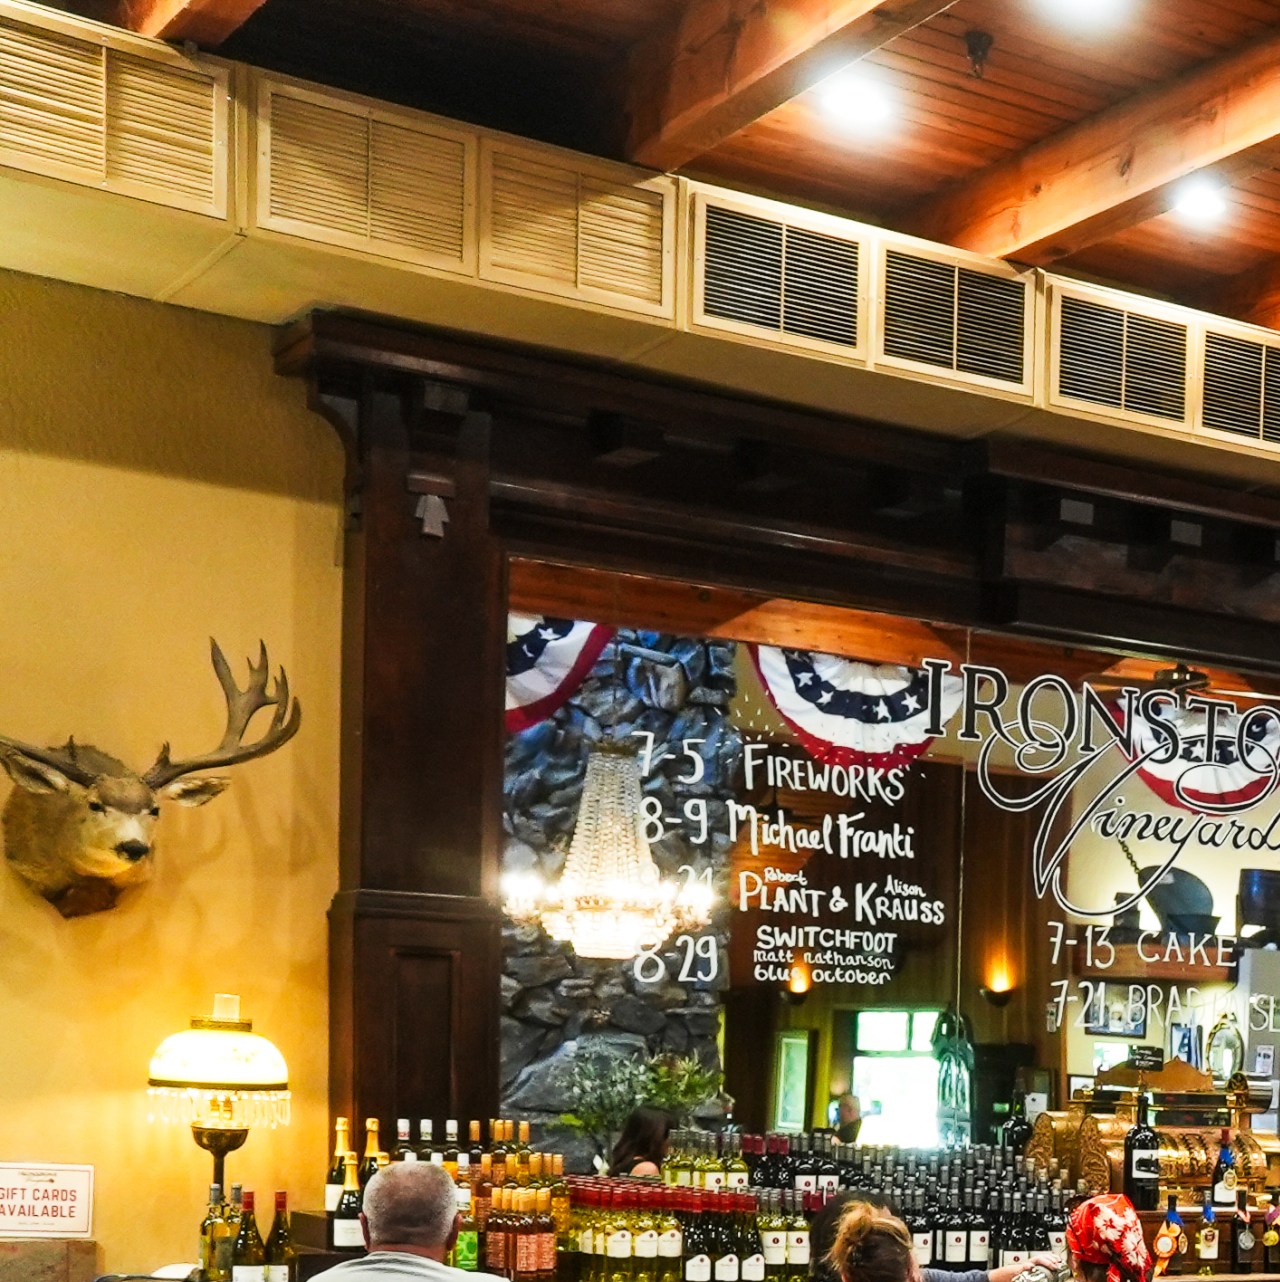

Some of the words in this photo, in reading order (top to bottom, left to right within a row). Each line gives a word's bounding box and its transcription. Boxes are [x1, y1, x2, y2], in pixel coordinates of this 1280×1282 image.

[631, 731, 706, 785] 7-5
[744, 743, 905, 806] FIREWORKS
[639, 797, 708, 845] 8-9
[726, 799, 831, 857] Michael
[837, 812, 915, 858] Franti
[764, 866, 808, 886] Robert
[884, 875, 927, 897] Alison
[738, 871, 827, 917] PLANT
[828, 886, 848, 912] &
[855, 882, 945, 925] KRAUSS
[633, 935, 719, 983] 8-29
[756, 925, 898, 954] SWITCHFOOT
[753, 949, 795, 963] matt
[803, 950, 895, 970] nathanson
[1047, 921, 1115, 969] 7-13
[1137, 930, 1238, 967] CAKE
[754, 964, 801, 982] blue
[811, 966, 891, 985] october
[1050, 980, 1105, 1027] 7-21
[1127, 984, 1200, 1028] BRAD
[0, 1187, 27, 1200] GIFT
[32, 1188, 77, 1202] CARDS
[0, 1204, 76, 1218] AVAILABLE
